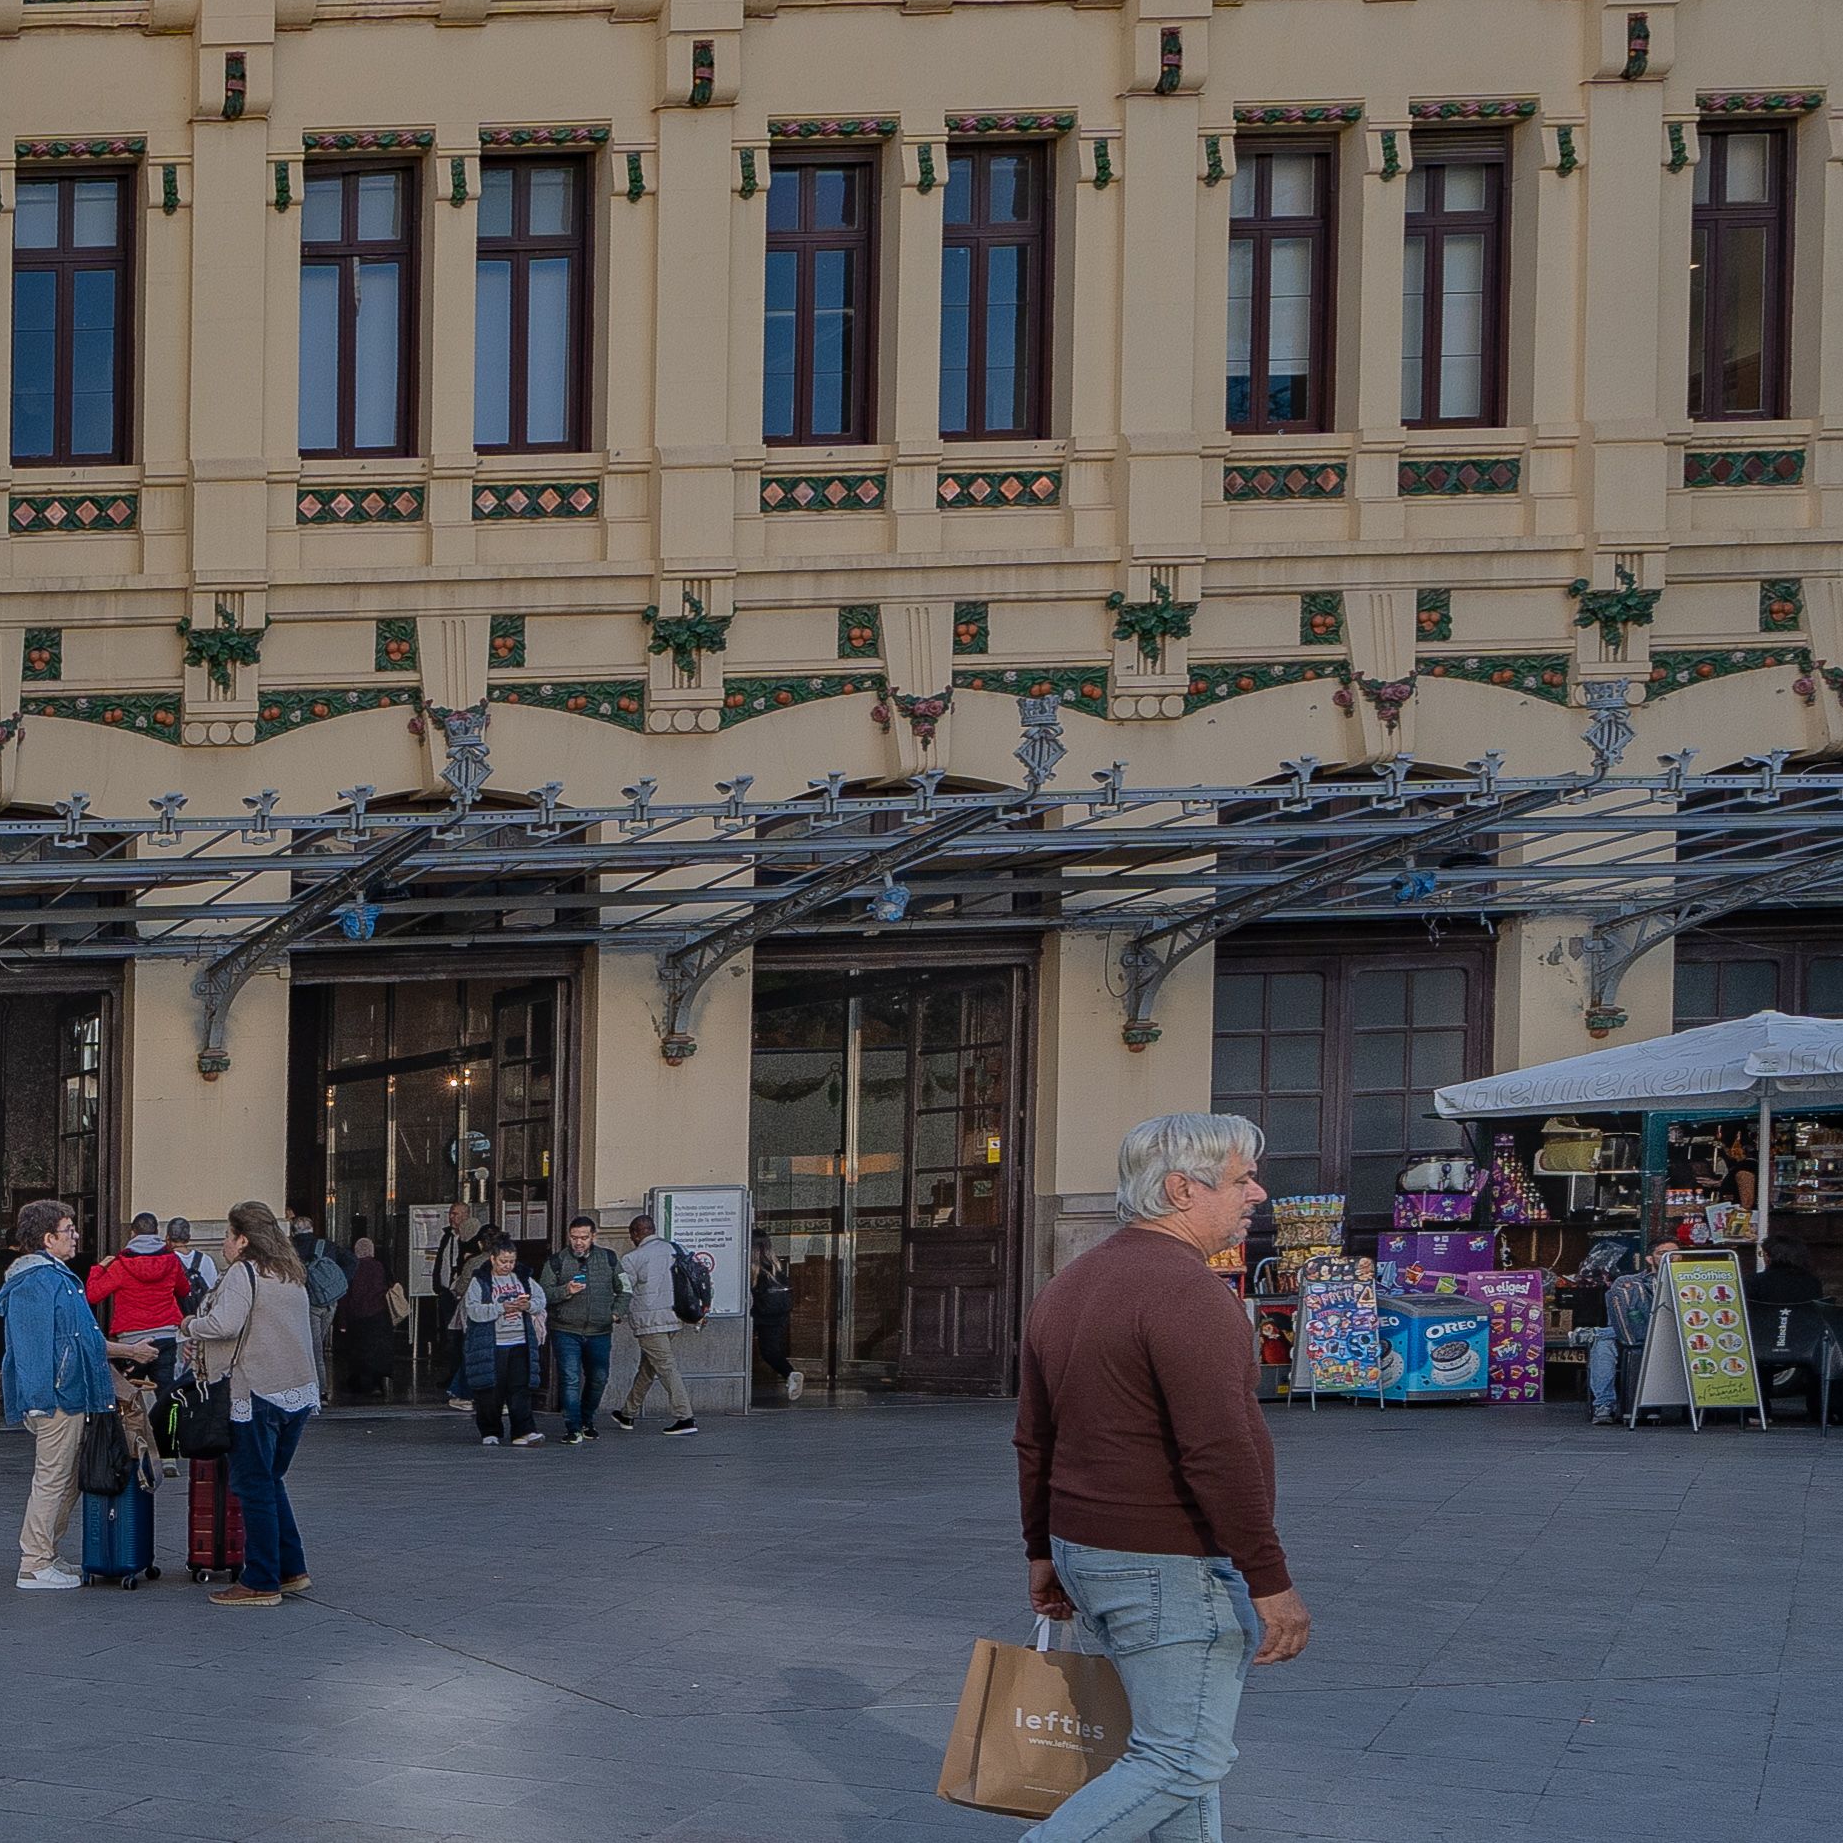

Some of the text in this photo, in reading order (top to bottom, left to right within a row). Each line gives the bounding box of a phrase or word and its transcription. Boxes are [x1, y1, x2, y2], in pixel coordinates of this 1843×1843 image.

[1464, 1063, 1726, 1109] Heineken
[1677, 1271, 1734, 1282] smoothies
[1425, 1320, 1478, 1339] OREO
[1015, 1707, 1105, 1740] lefties
[1028, 1737, 1094, 1754] www.lefties.com
